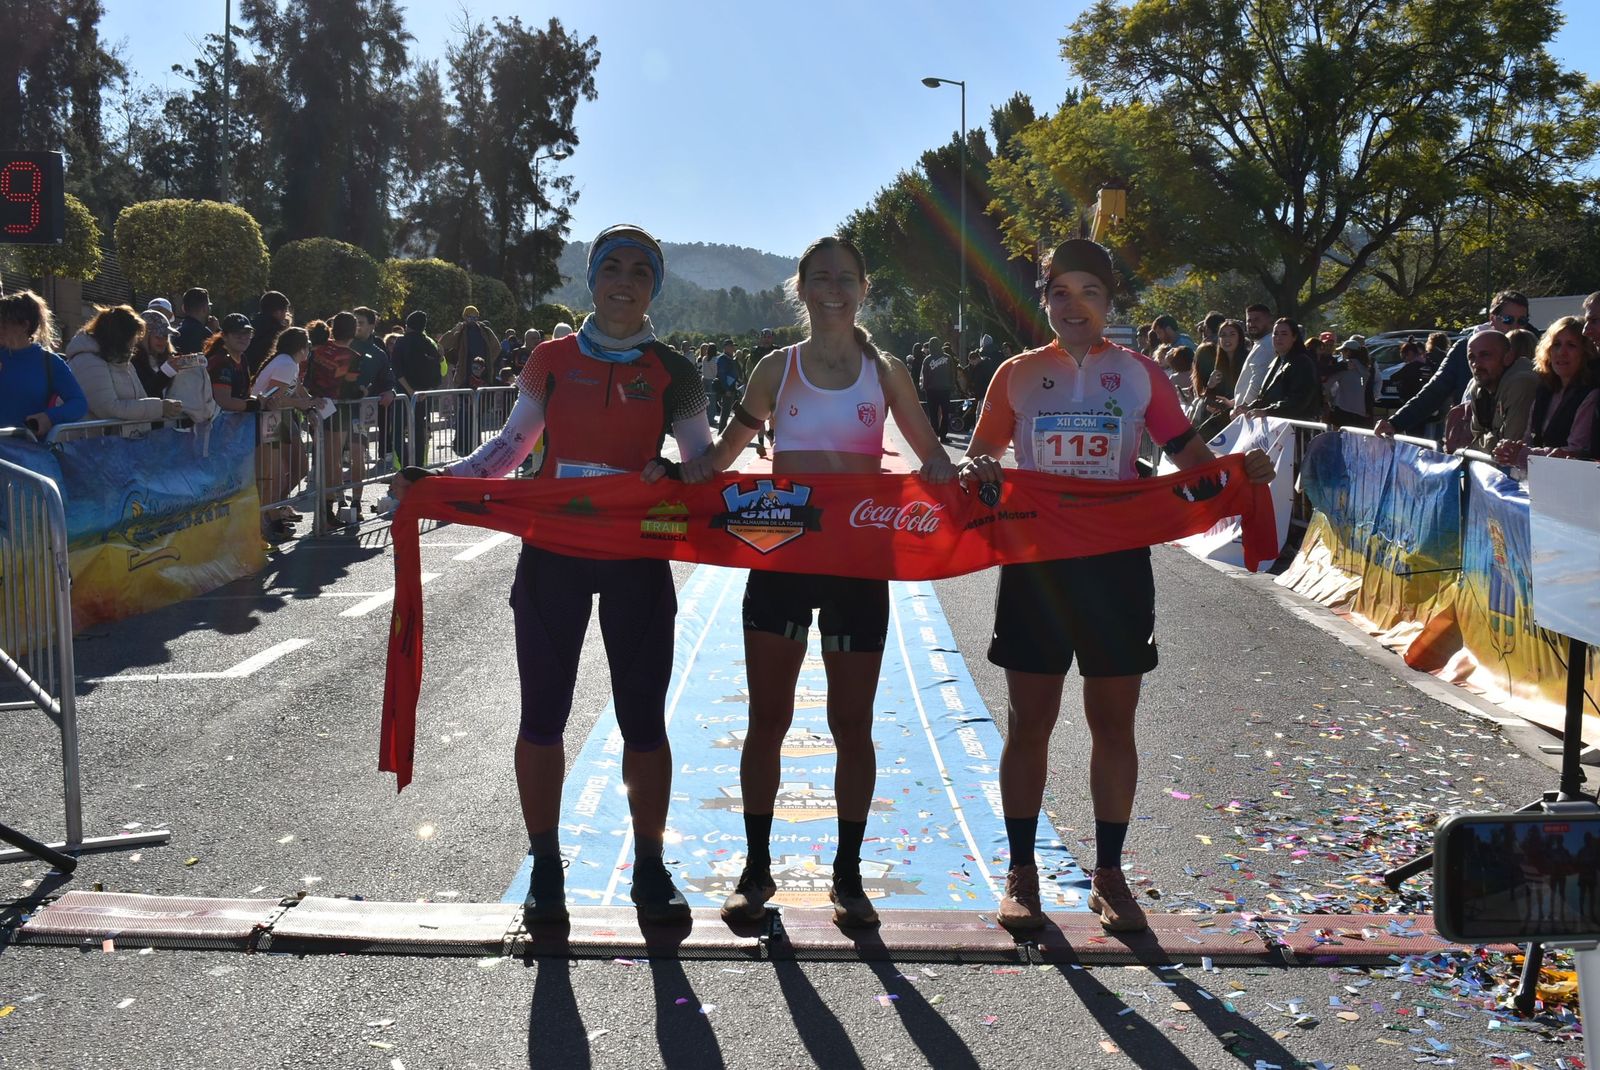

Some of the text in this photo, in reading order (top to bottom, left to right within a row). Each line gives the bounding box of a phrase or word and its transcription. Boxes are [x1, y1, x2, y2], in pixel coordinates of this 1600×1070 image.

[1, 162, 41, 233] 9
[1056, 418, 1097, 427] XII CXM
[1046, 434, 1109, 457] 113
[850, 498, 945, 533] Coca-Cola
[998, 510, 1037, 521] Motors
[645, 520, 683, 534] TRAIL
